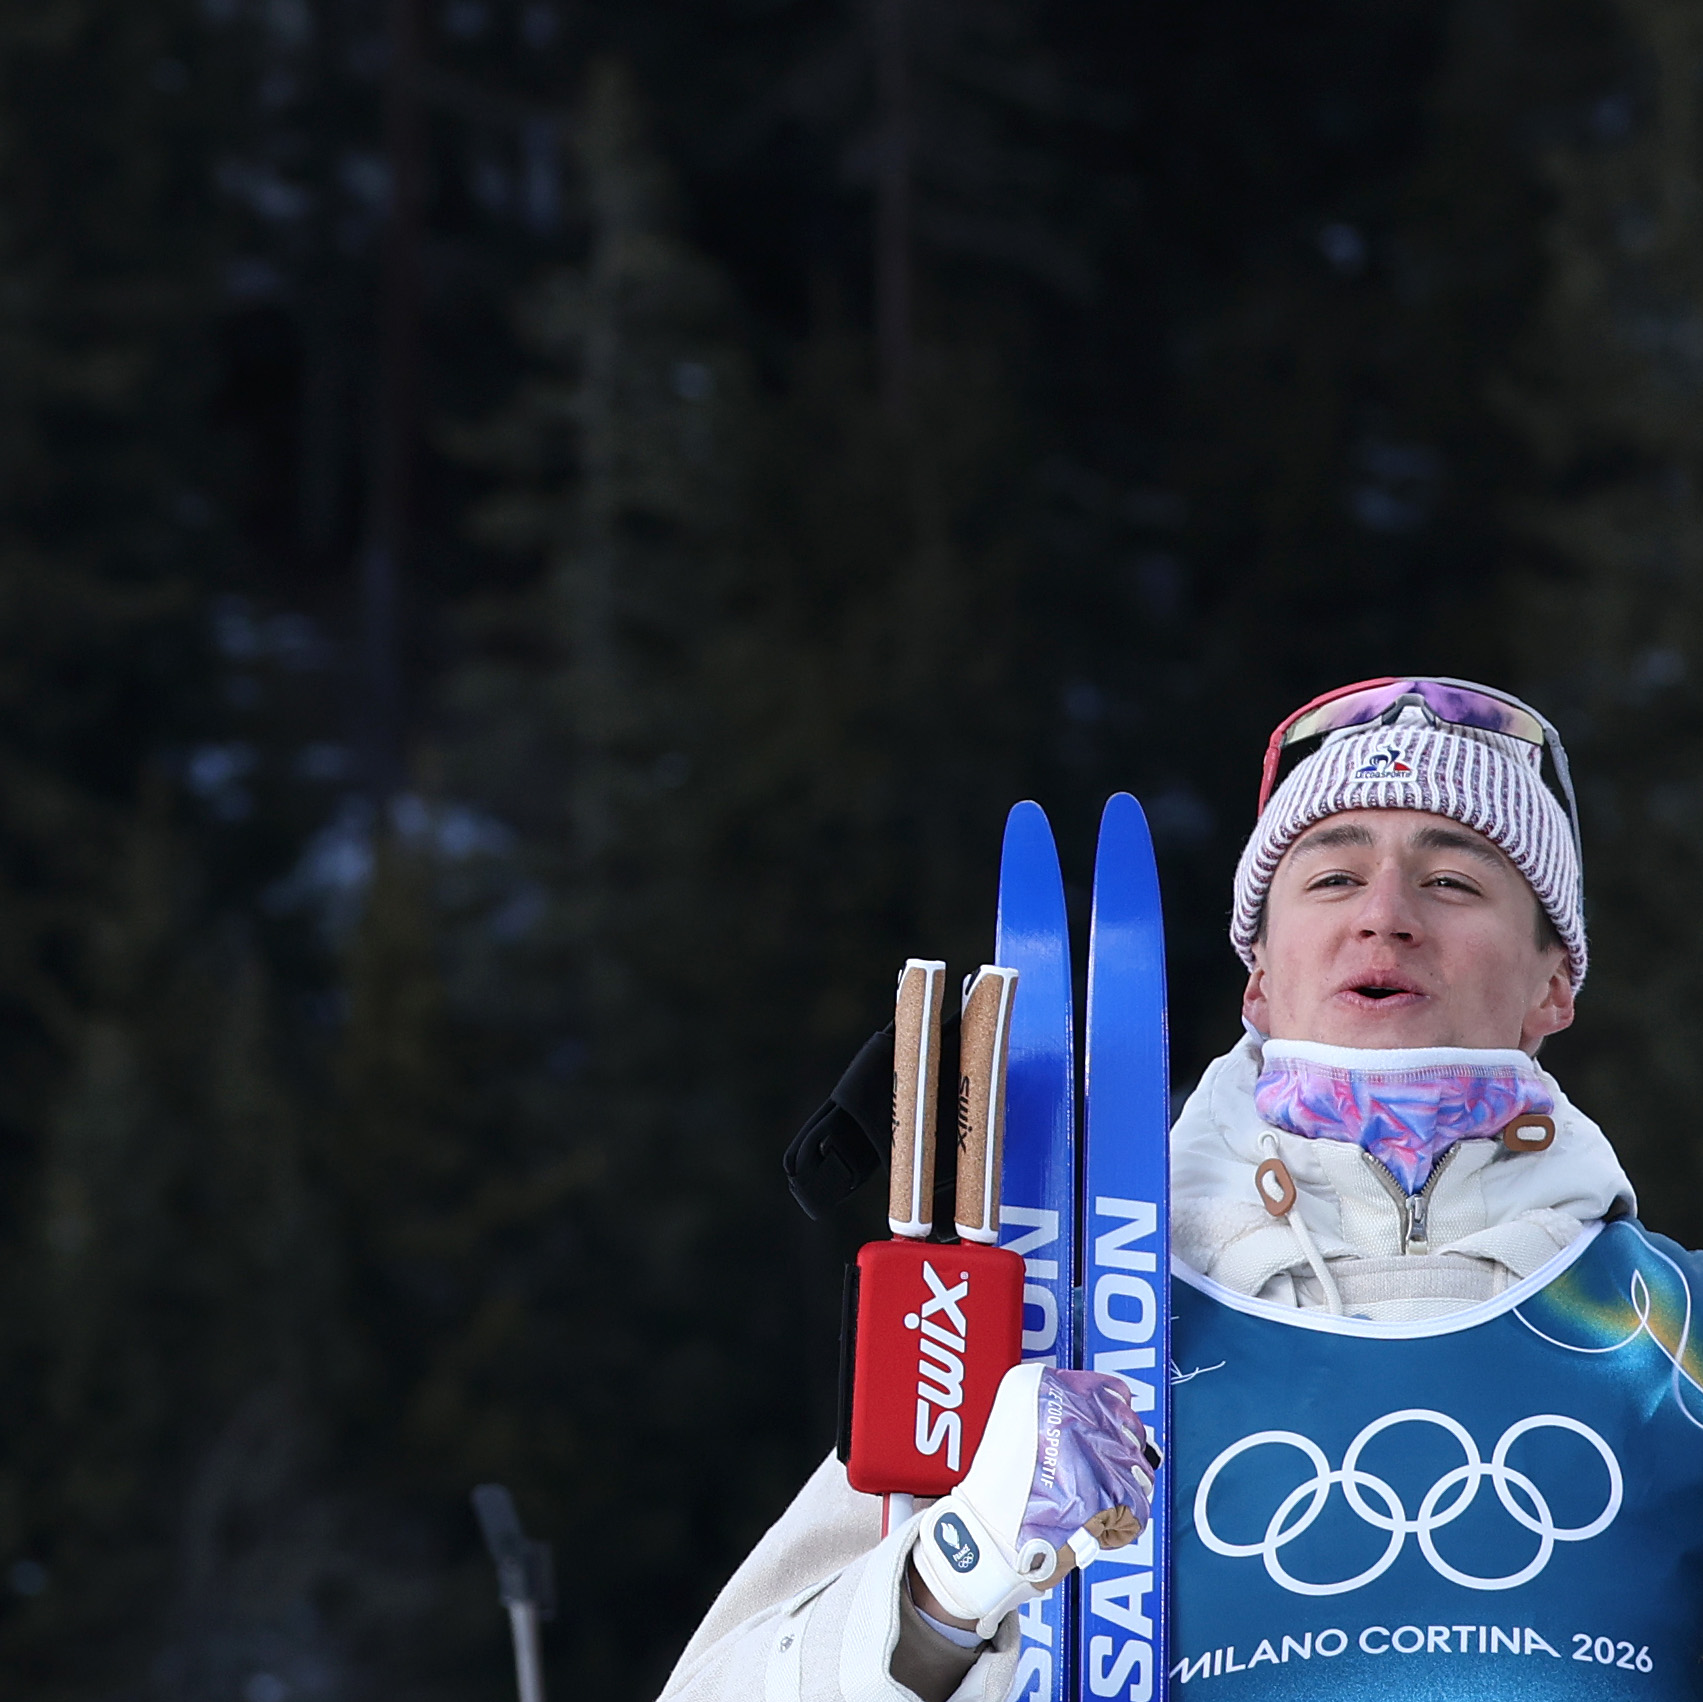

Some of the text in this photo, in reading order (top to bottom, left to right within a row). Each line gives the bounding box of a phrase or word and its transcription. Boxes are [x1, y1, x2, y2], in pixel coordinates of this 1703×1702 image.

[1048, 1401, 1063, 1426] COQ
[1041, 1428, 1061, 1489] SPORTIF
[1168, 1625, 1654, 1684] MILANO CORTINA 2026
